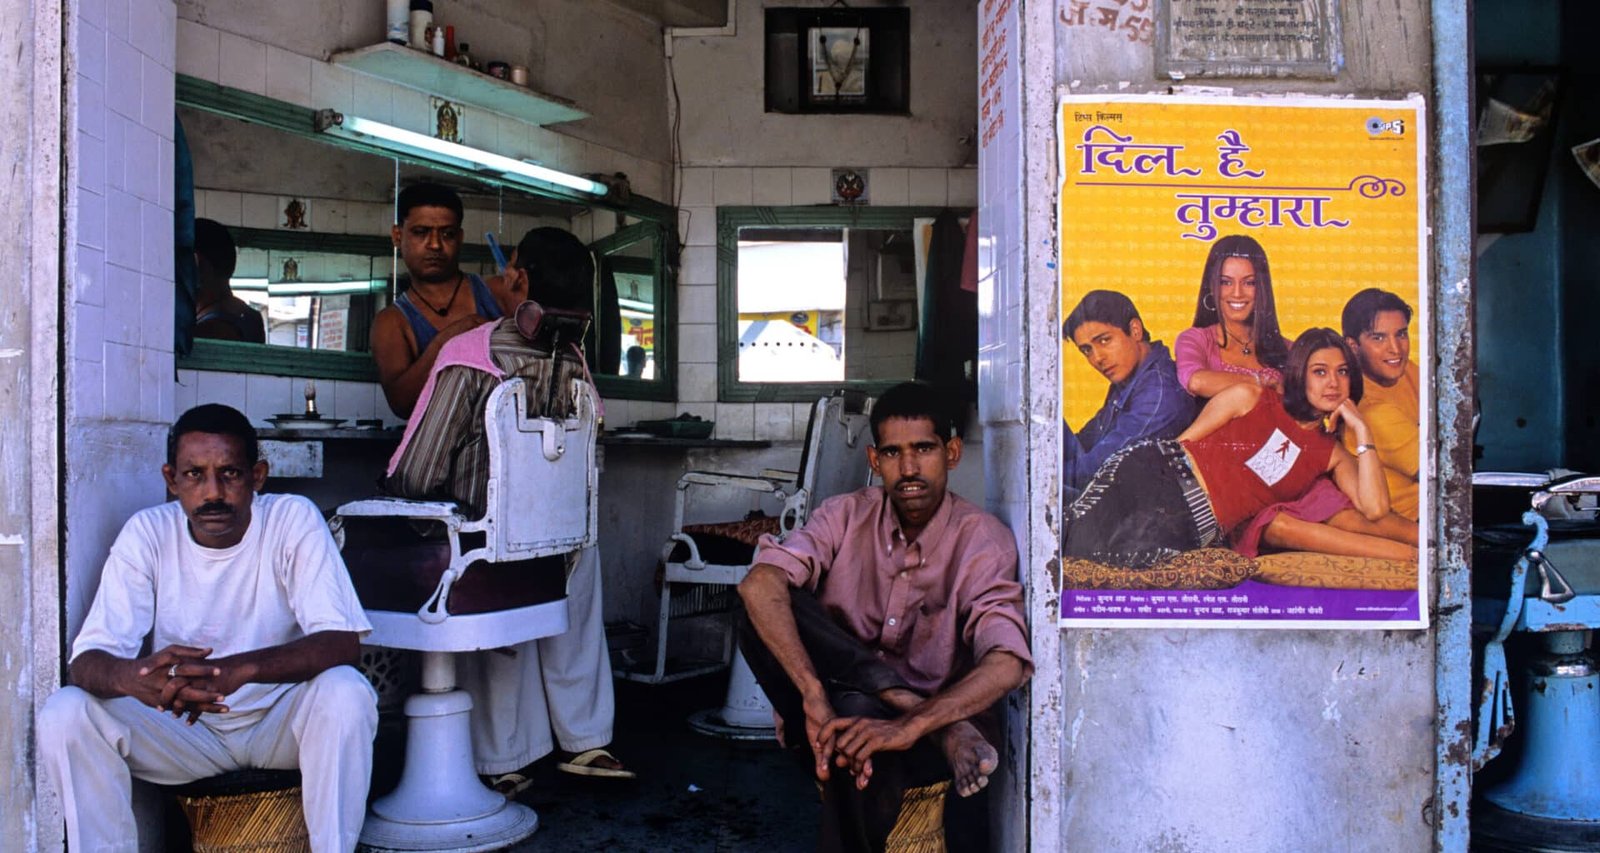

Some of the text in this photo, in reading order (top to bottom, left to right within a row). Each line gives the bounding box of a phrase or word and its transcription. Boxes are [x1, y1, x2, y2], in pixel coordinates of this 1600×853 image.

[1076, 125, 1265, 178] दिल है
[1176, 194, 1350, 241] तुम्हारा
